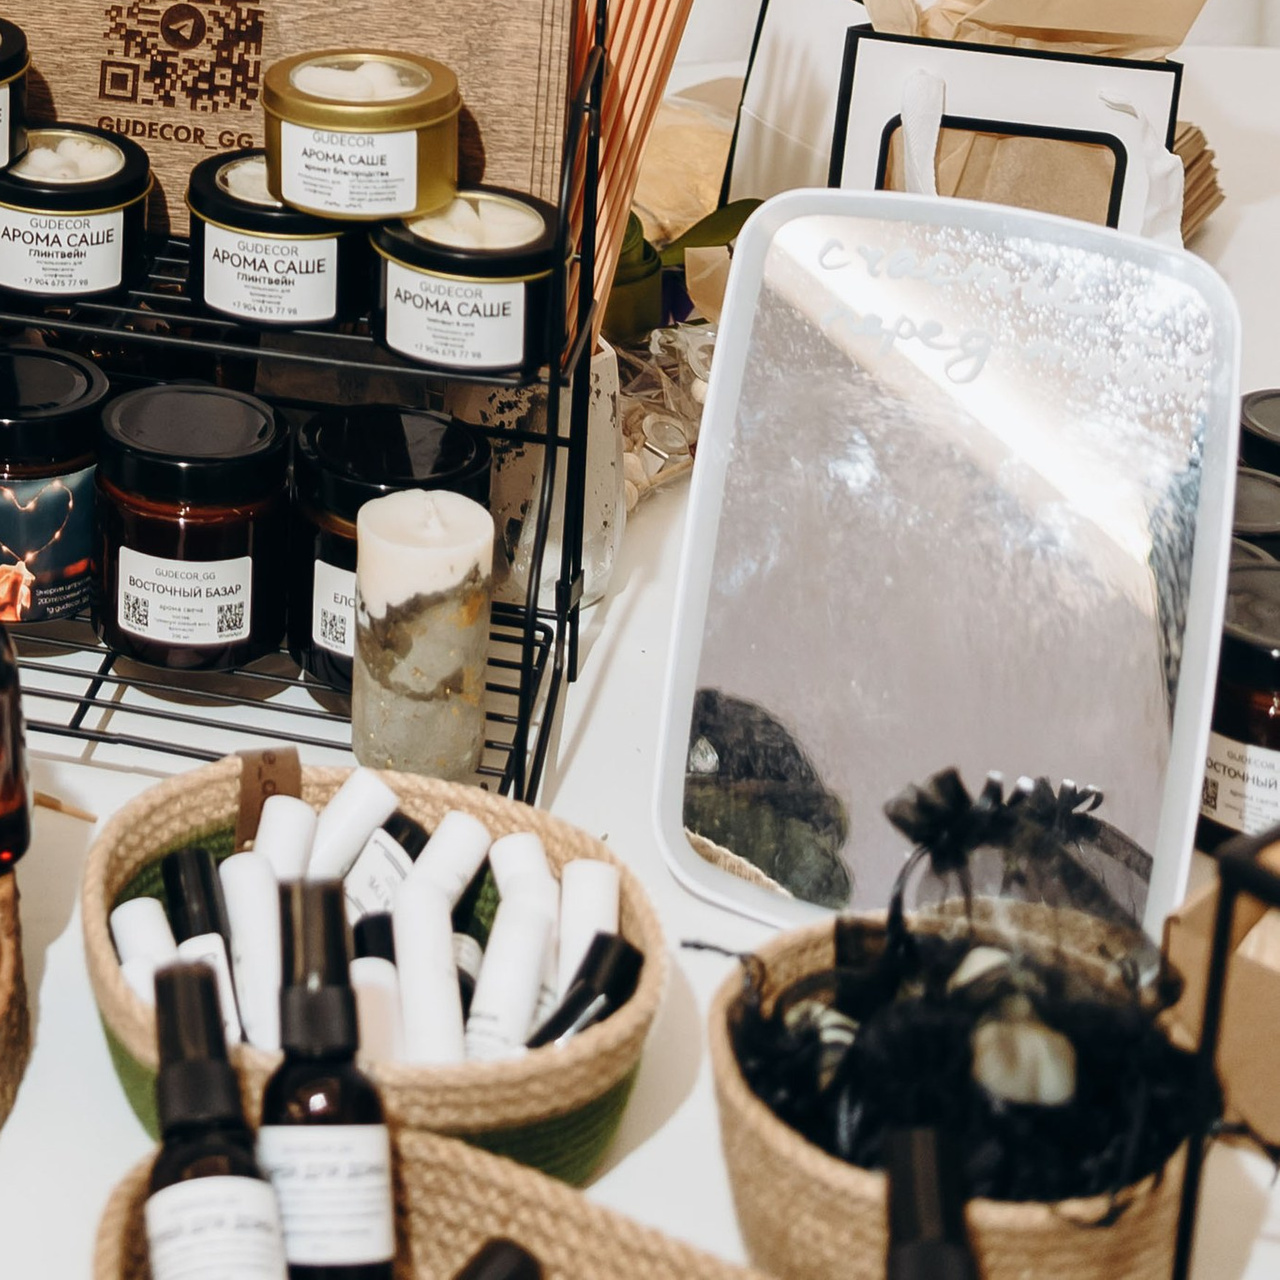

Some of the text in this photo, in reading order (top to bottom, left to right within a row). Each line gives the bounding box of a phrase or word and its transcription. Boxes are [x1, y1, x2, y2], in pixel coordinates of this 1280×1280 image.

[97, 116, 254, 150] GUDECOR_GG
[312, 131, 375, 147] GUDECOR
[301, 147, 387, 166] АРОМА САШЕ
[30, 217, 91, 230] GUDECOR
[1, 226, 114, 247] АРОМА САШЕ
[28, 248, 87, 259] глинтвейн
[237, 240, 298, 256] GUDECOR
[212, 247, 326, 274] АРОМА САШЕ
[420, 281, 483, 299] GUDECOR
[394, 287, 511, 317] АРОМА САШЕ
[155, 567, 216, 582] GUDECOR_GG
[129, 575, 241, 598] ВОСТОЧНЫЙ БАЗАР
[1206, 757, 1278, 790] ОСТОЧНЫЙ
